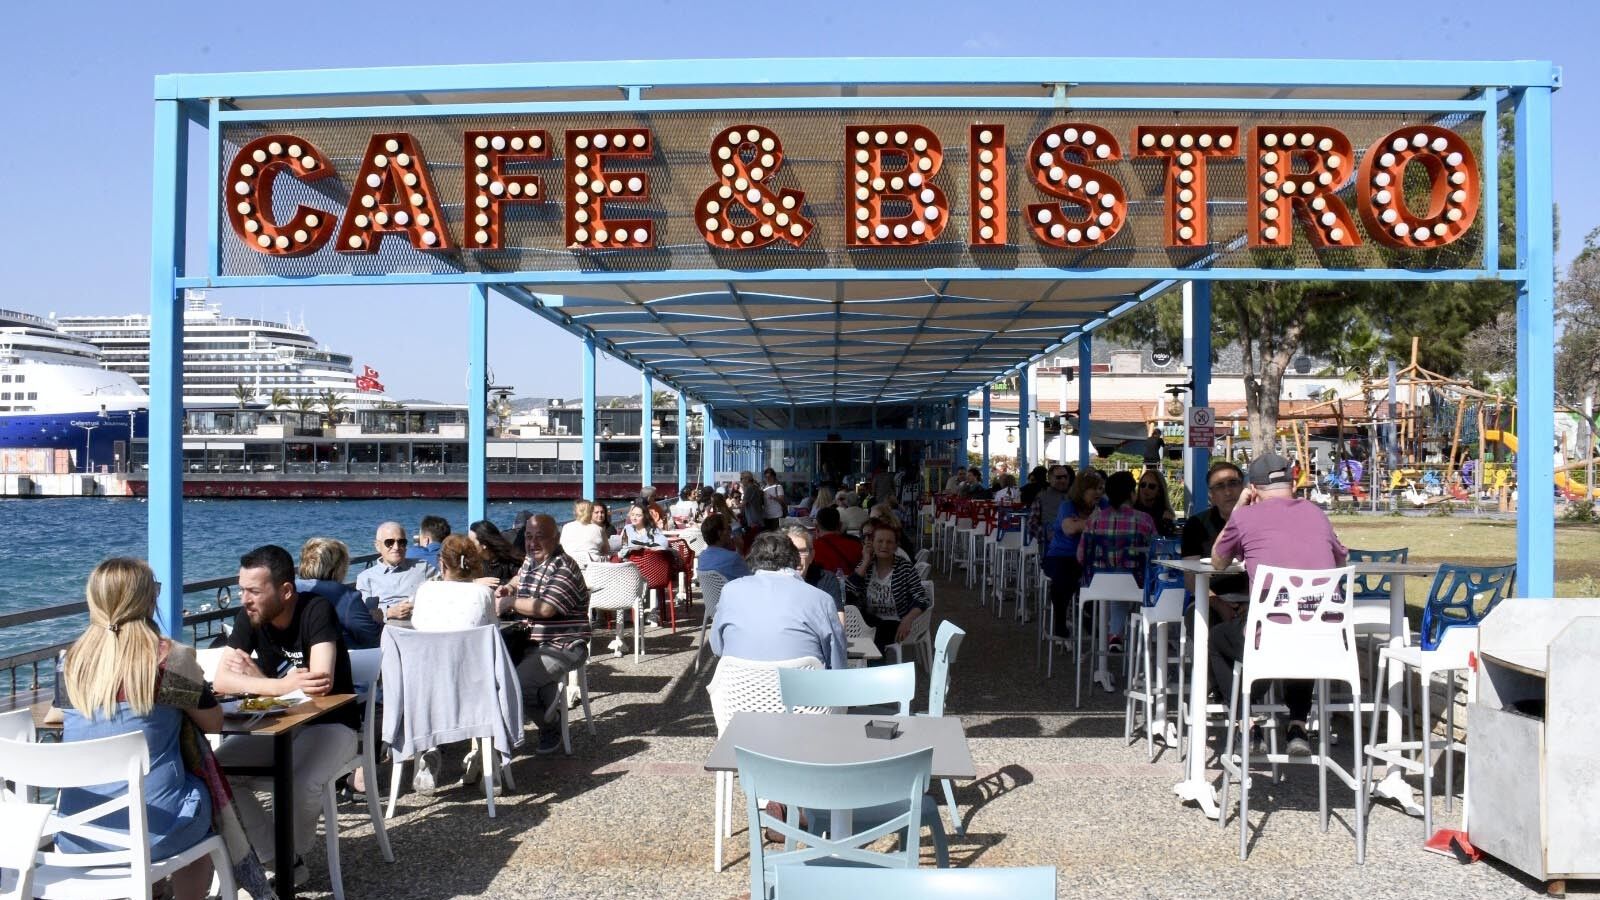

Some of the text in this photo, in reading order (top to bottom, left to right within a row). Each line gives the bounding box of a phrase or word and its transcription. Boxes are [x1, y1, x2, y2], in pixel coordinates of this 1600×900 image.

[226, 123, 1480, 256] CAFE & BISTRO
